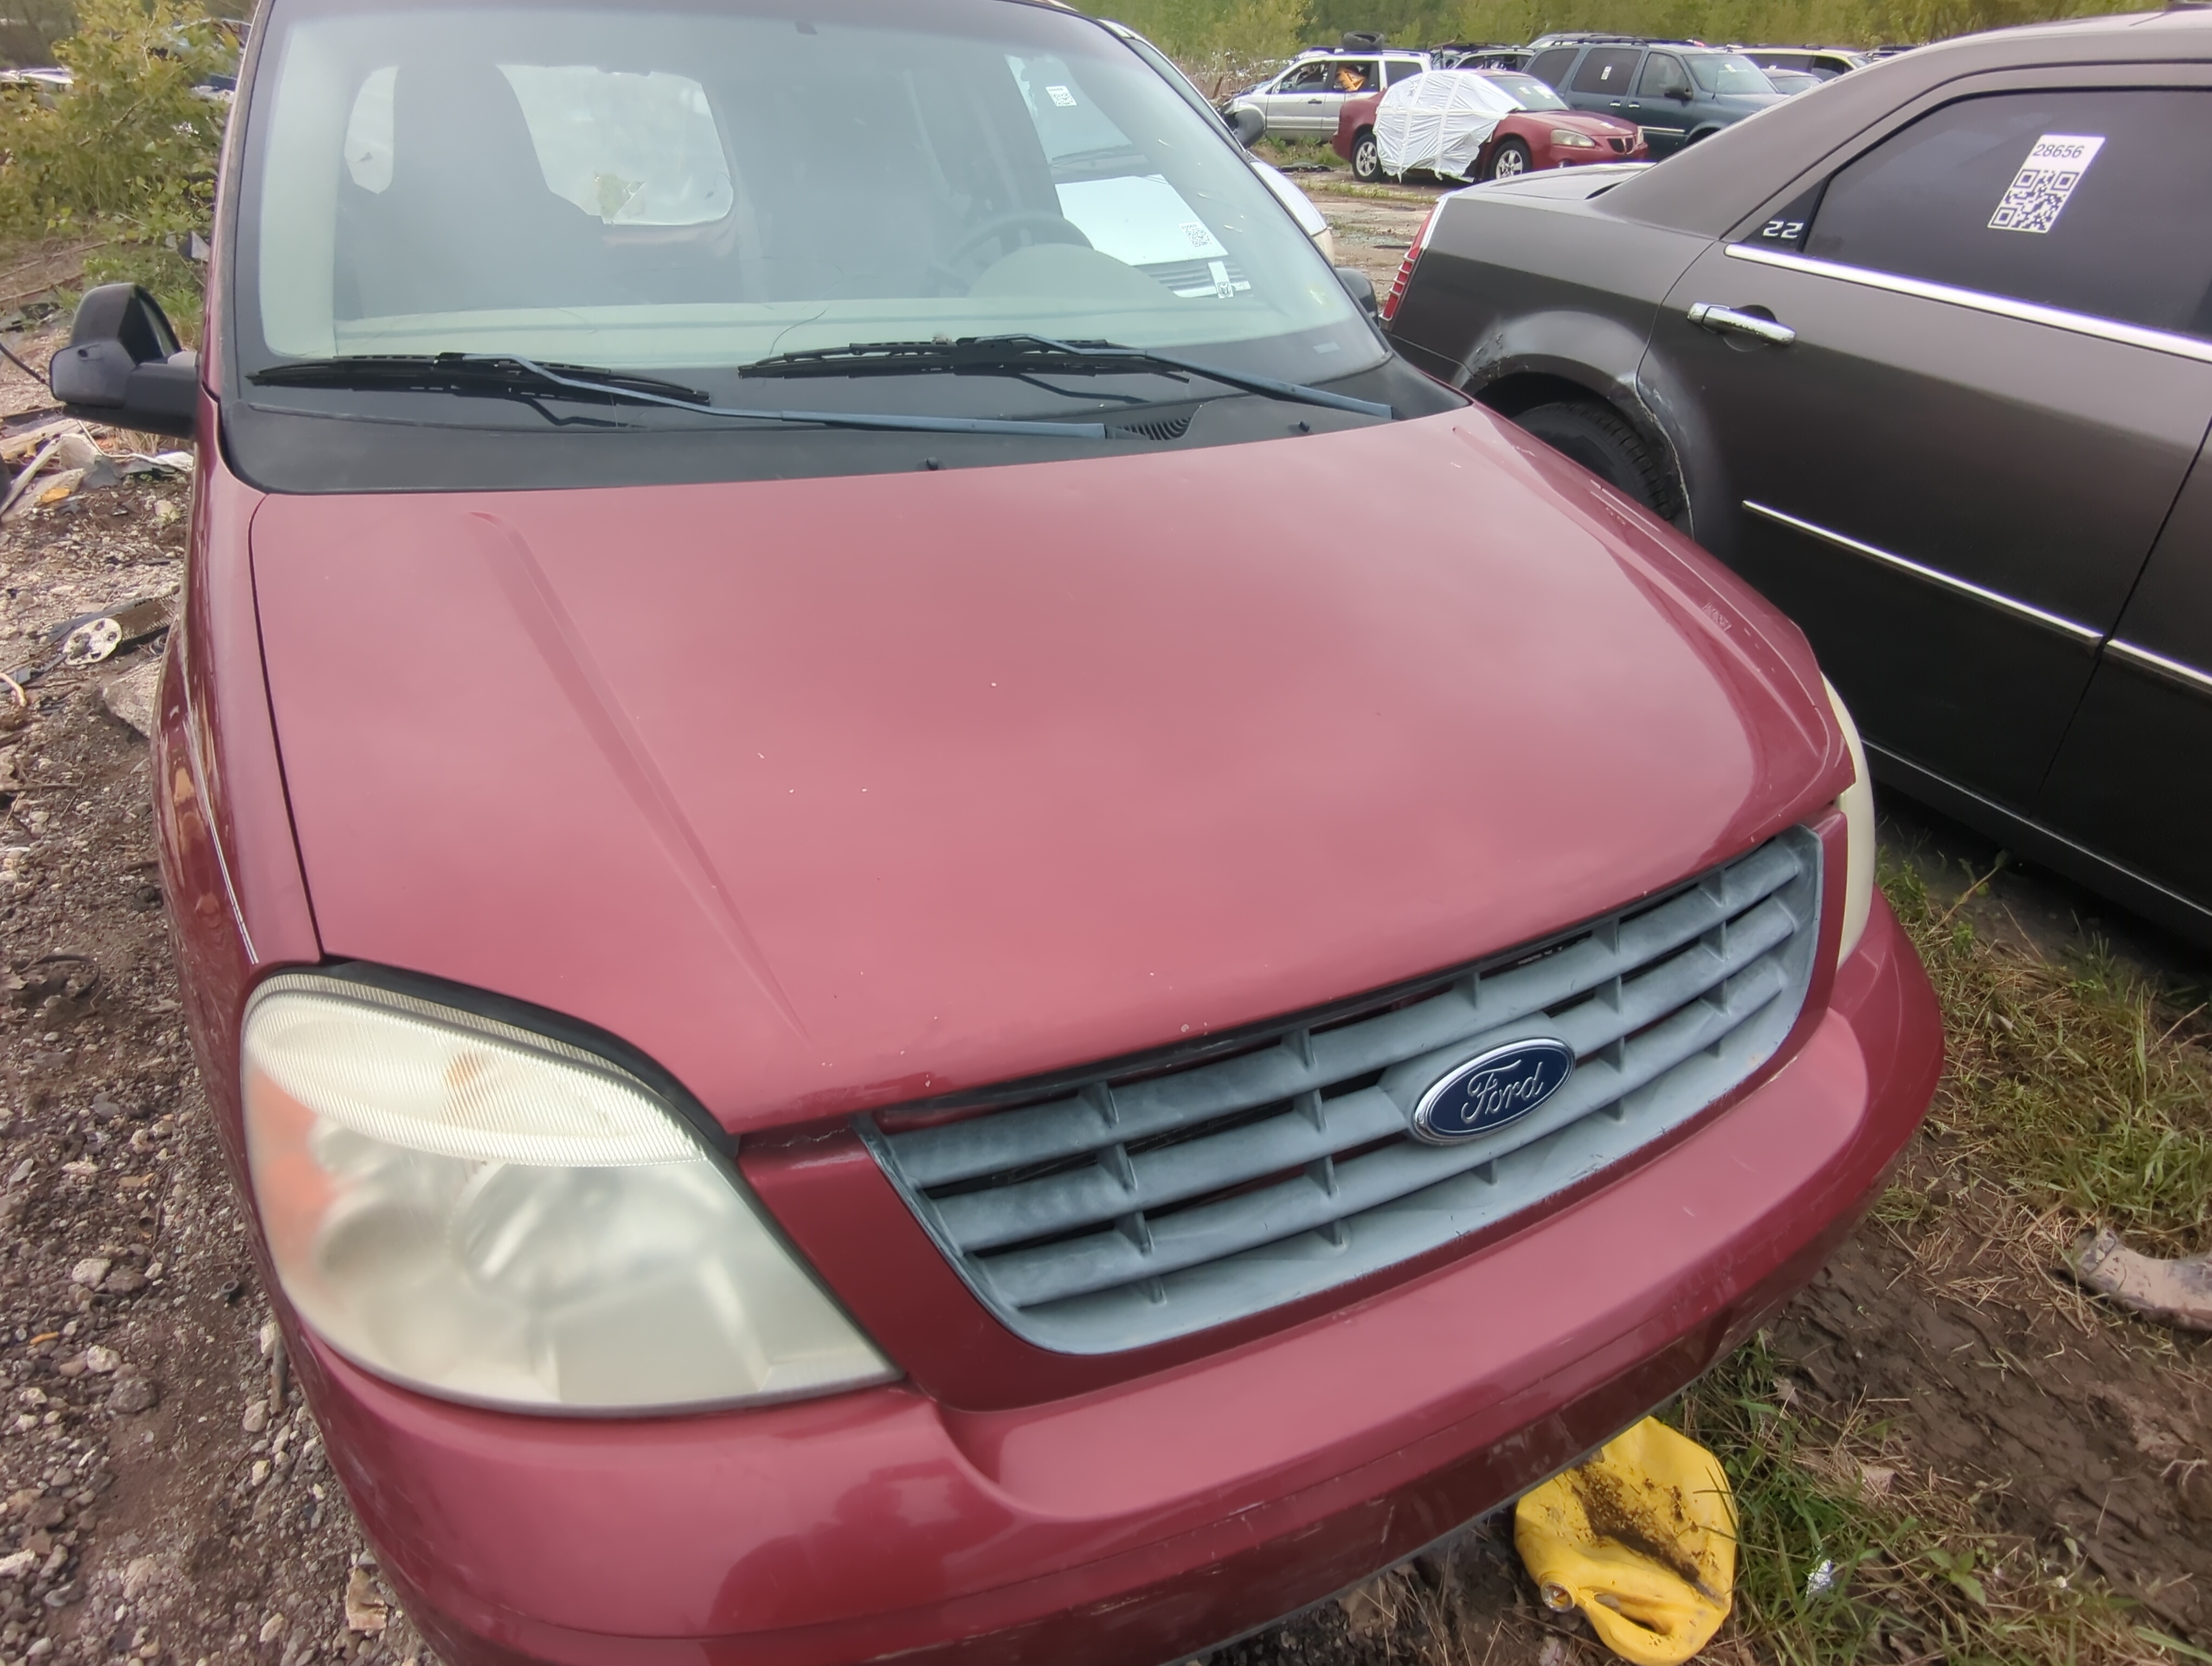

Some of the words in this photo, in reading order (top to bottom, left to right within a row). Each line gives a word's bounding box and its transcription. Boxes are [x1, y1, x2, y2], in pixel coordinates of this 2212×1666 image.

[2033, 144, 2084, 158] 28656
[1763, 220, 1804, 239] 22
[1461, 1059, 1544, 1124] Ford
